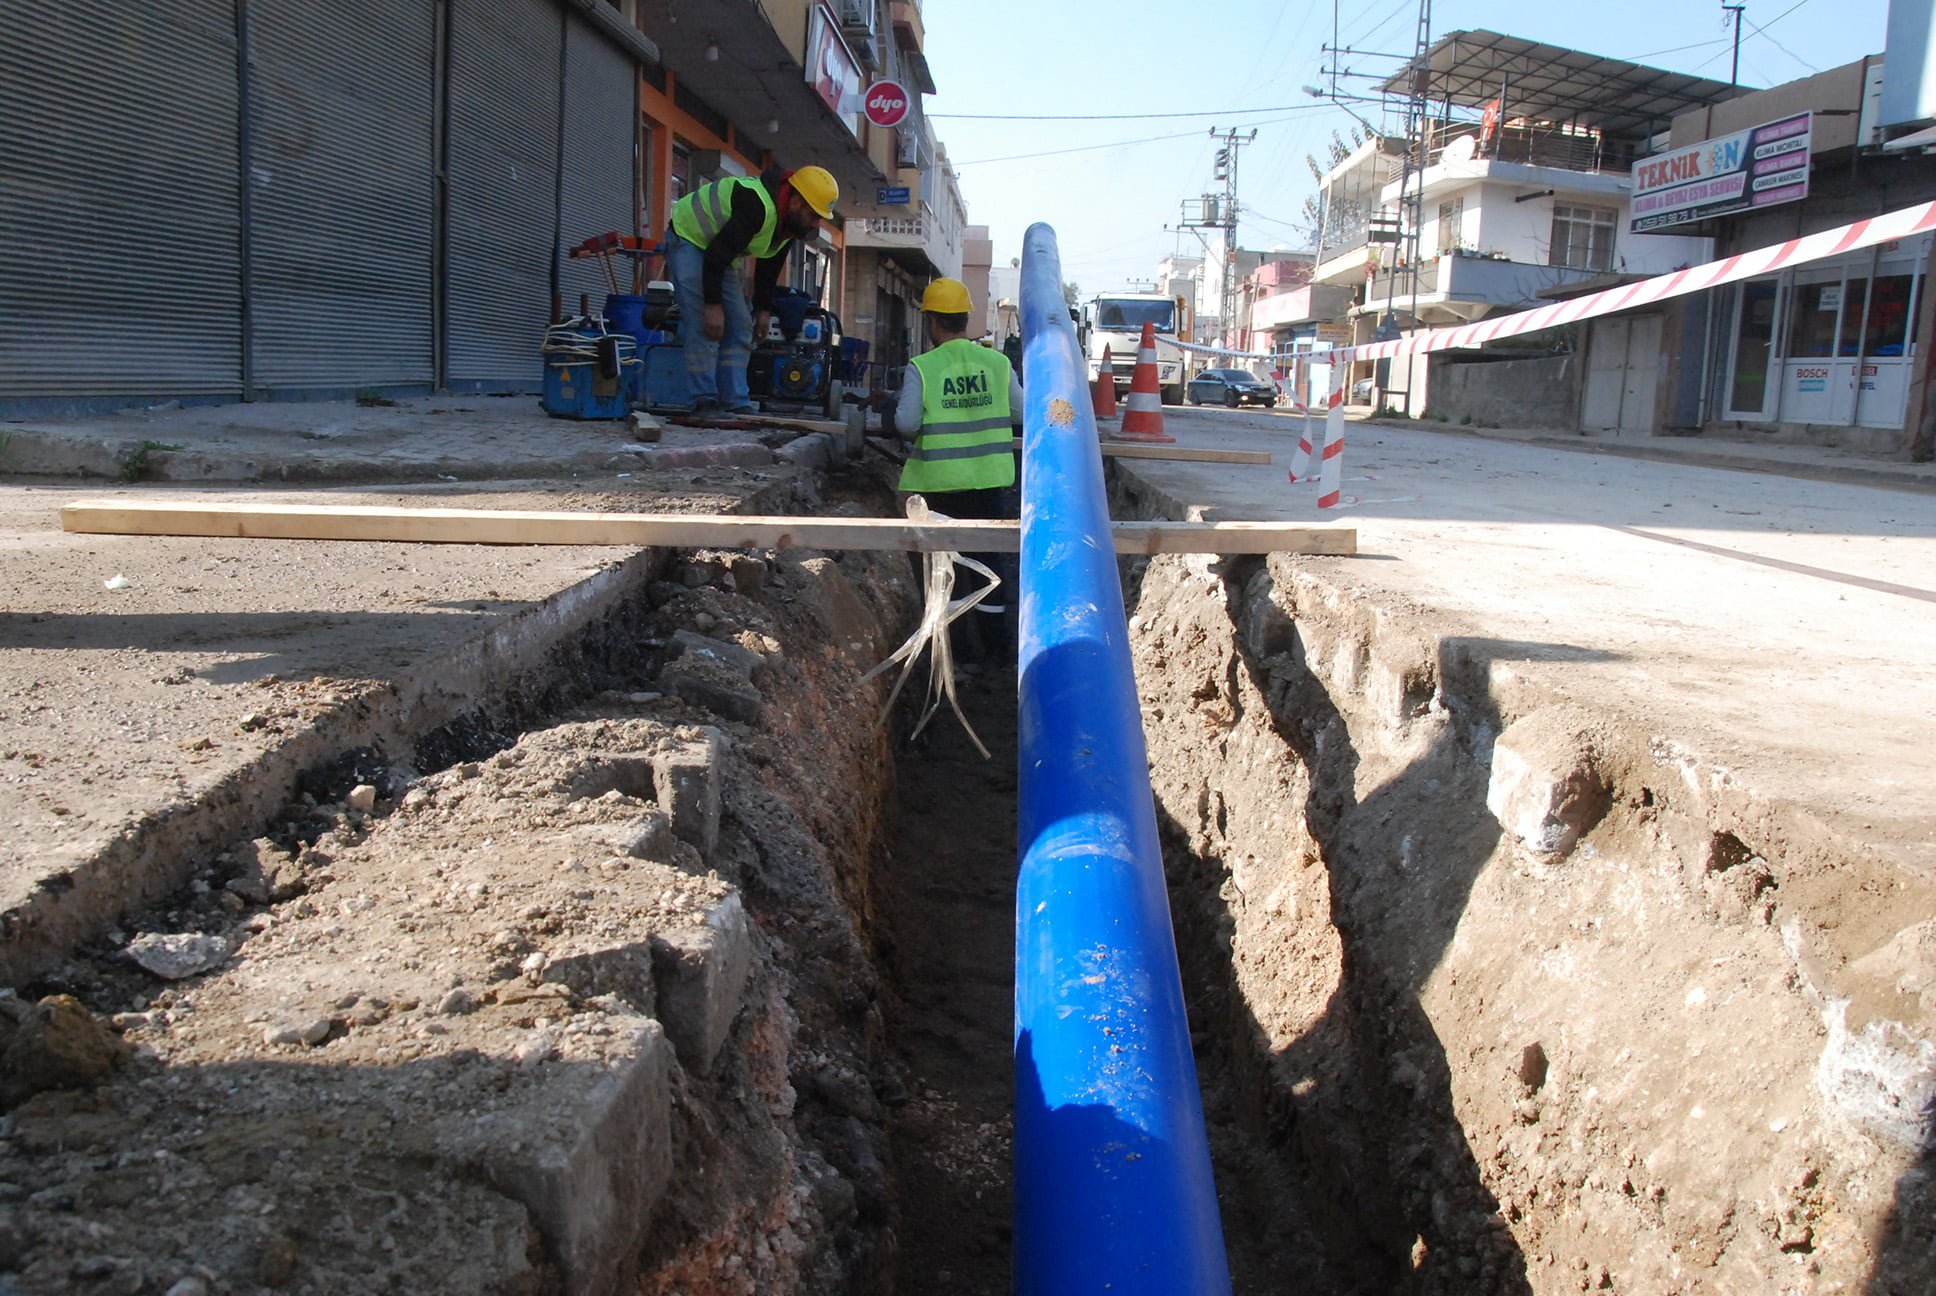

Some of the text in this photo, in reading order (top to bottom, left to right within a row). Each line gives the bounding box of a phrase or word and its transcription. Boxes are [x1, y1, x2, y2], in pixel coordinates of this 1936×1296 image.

[870, 95, 904, 113] dyo
[1796, 368, 1829, 379] BOSCH
[943, 370, 988, 396] ASKİ
